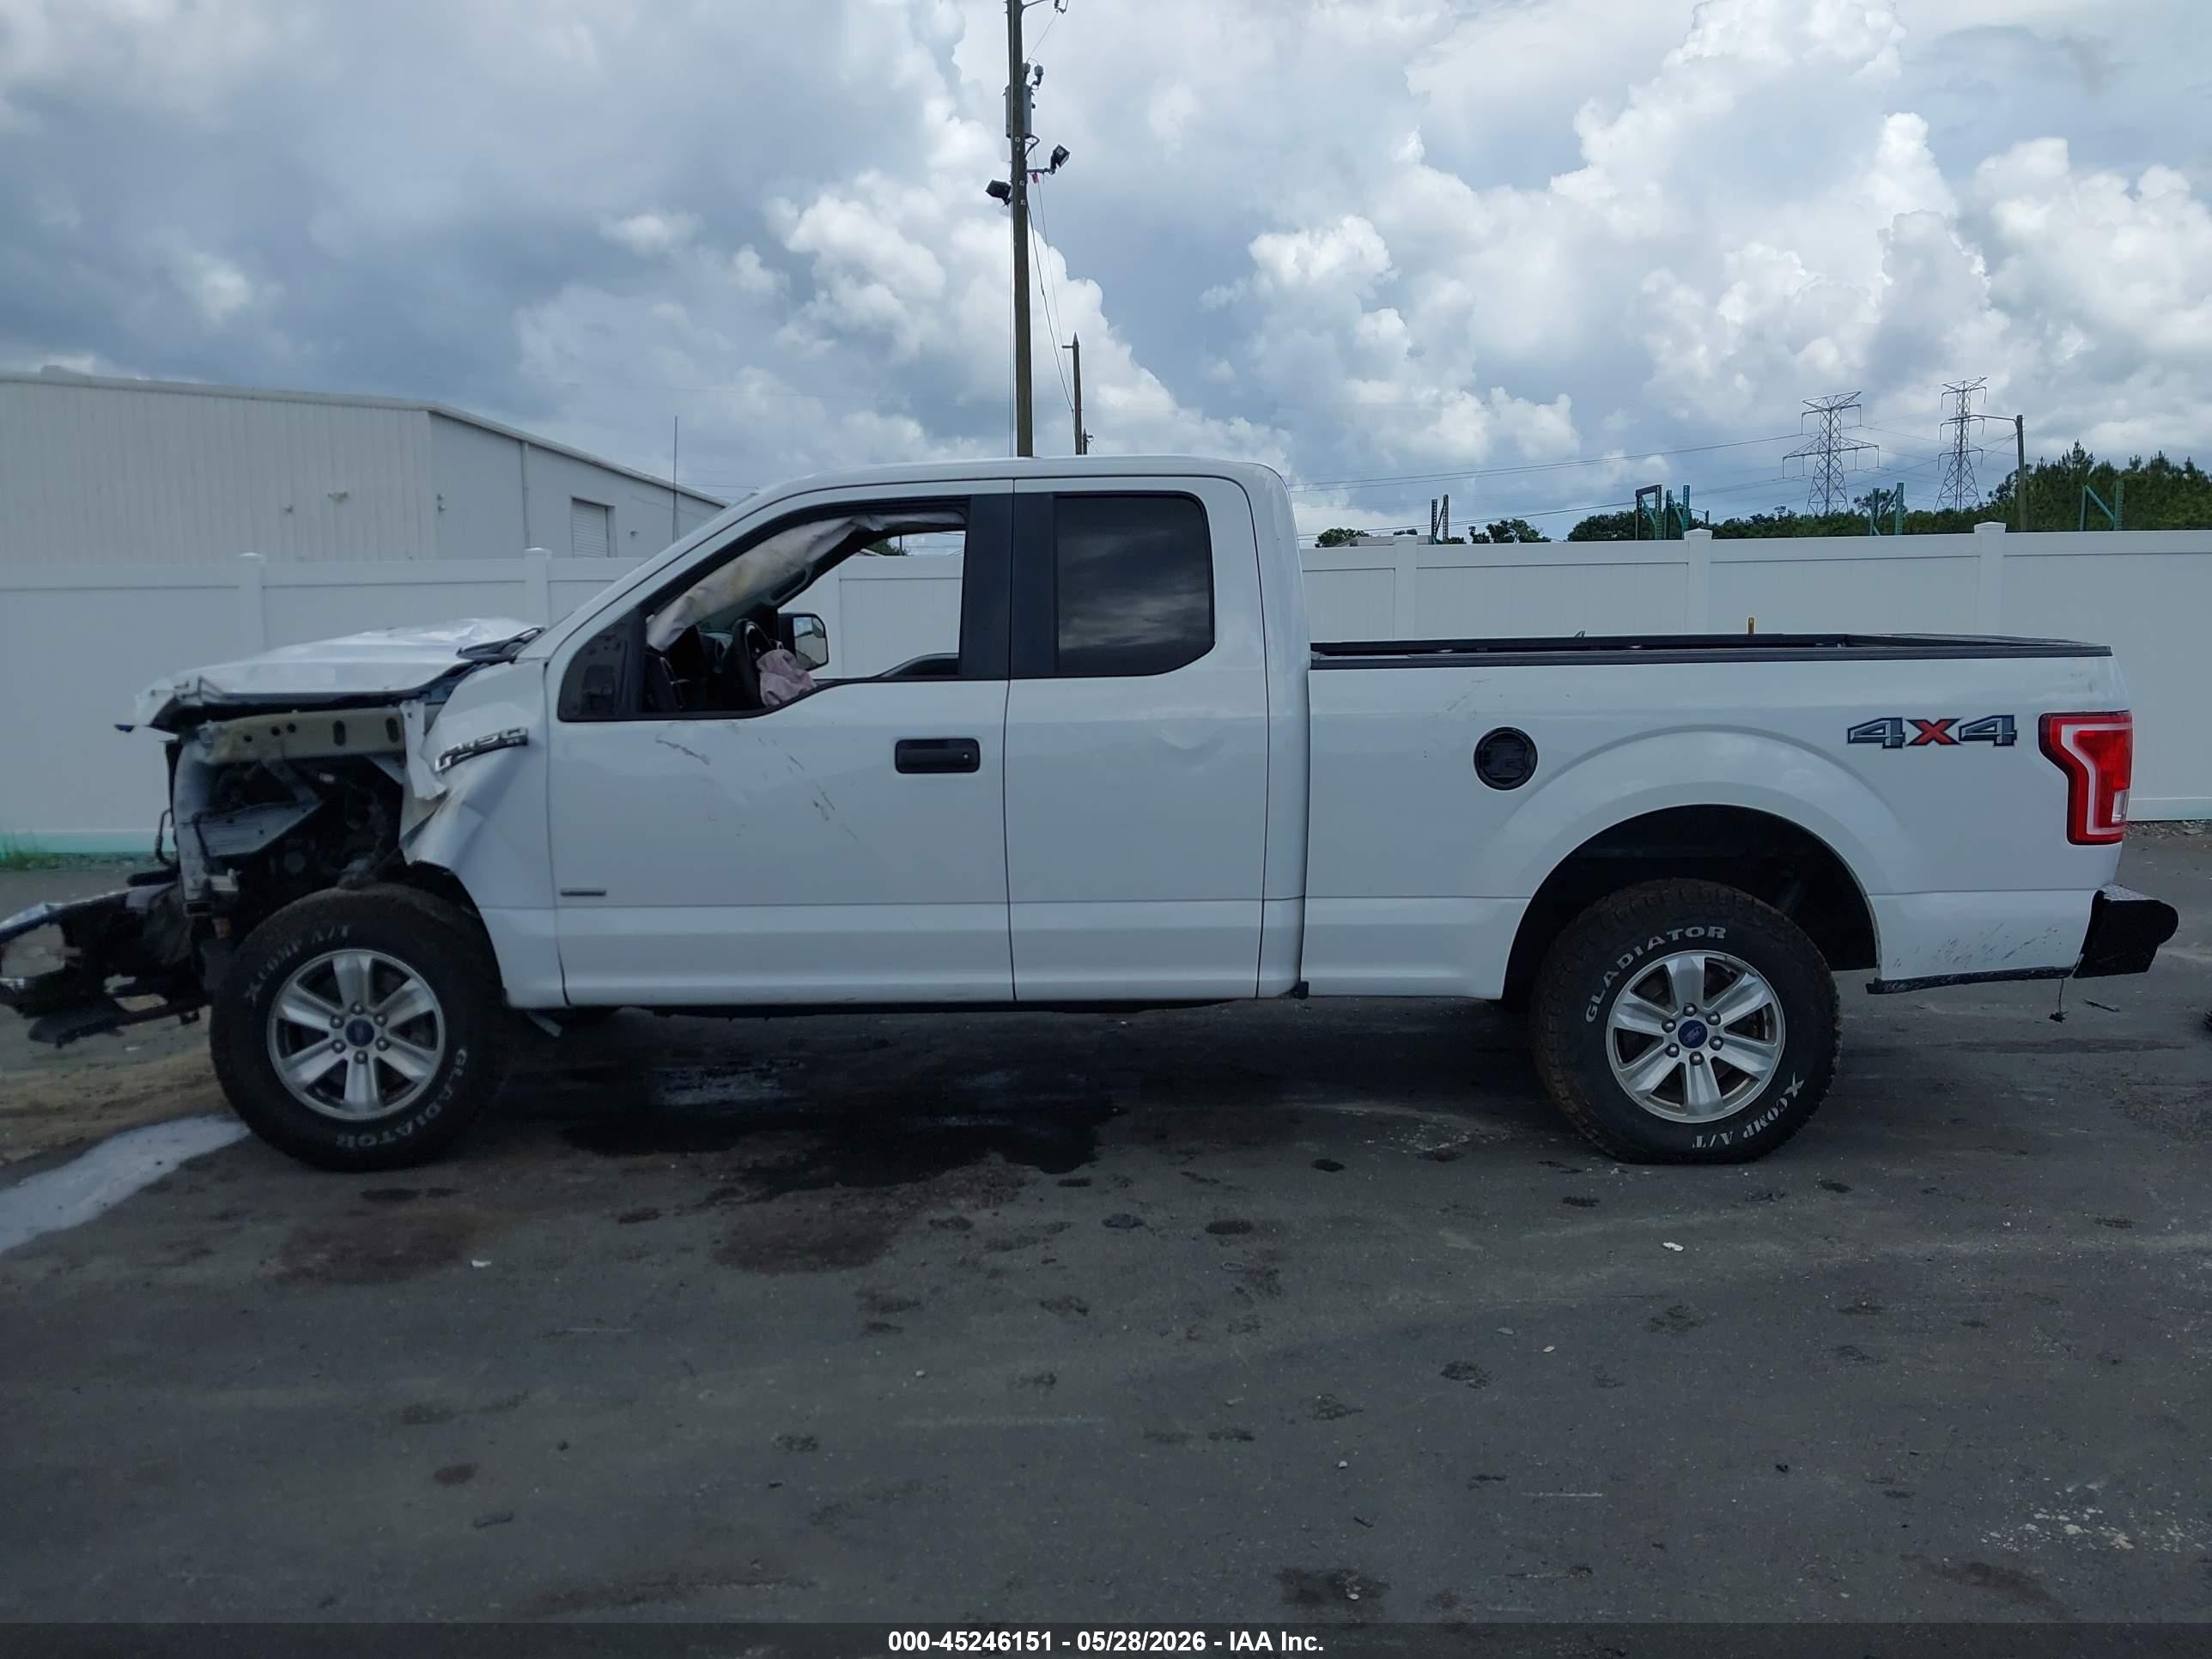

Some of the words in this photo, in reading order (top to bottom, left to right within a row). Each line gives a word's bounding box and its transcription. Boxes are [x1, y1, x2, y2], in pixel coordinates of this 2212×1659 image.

[1584, 925, 1729, 1024] GLADIATOR
[334, 1046, 469, 1149] GLADIATOR
[1782, 1071, 1806, 1099] X
[1742, 1097, 1789, 1139] COMP
[1692, 1130, 1735, 1149] A/T
